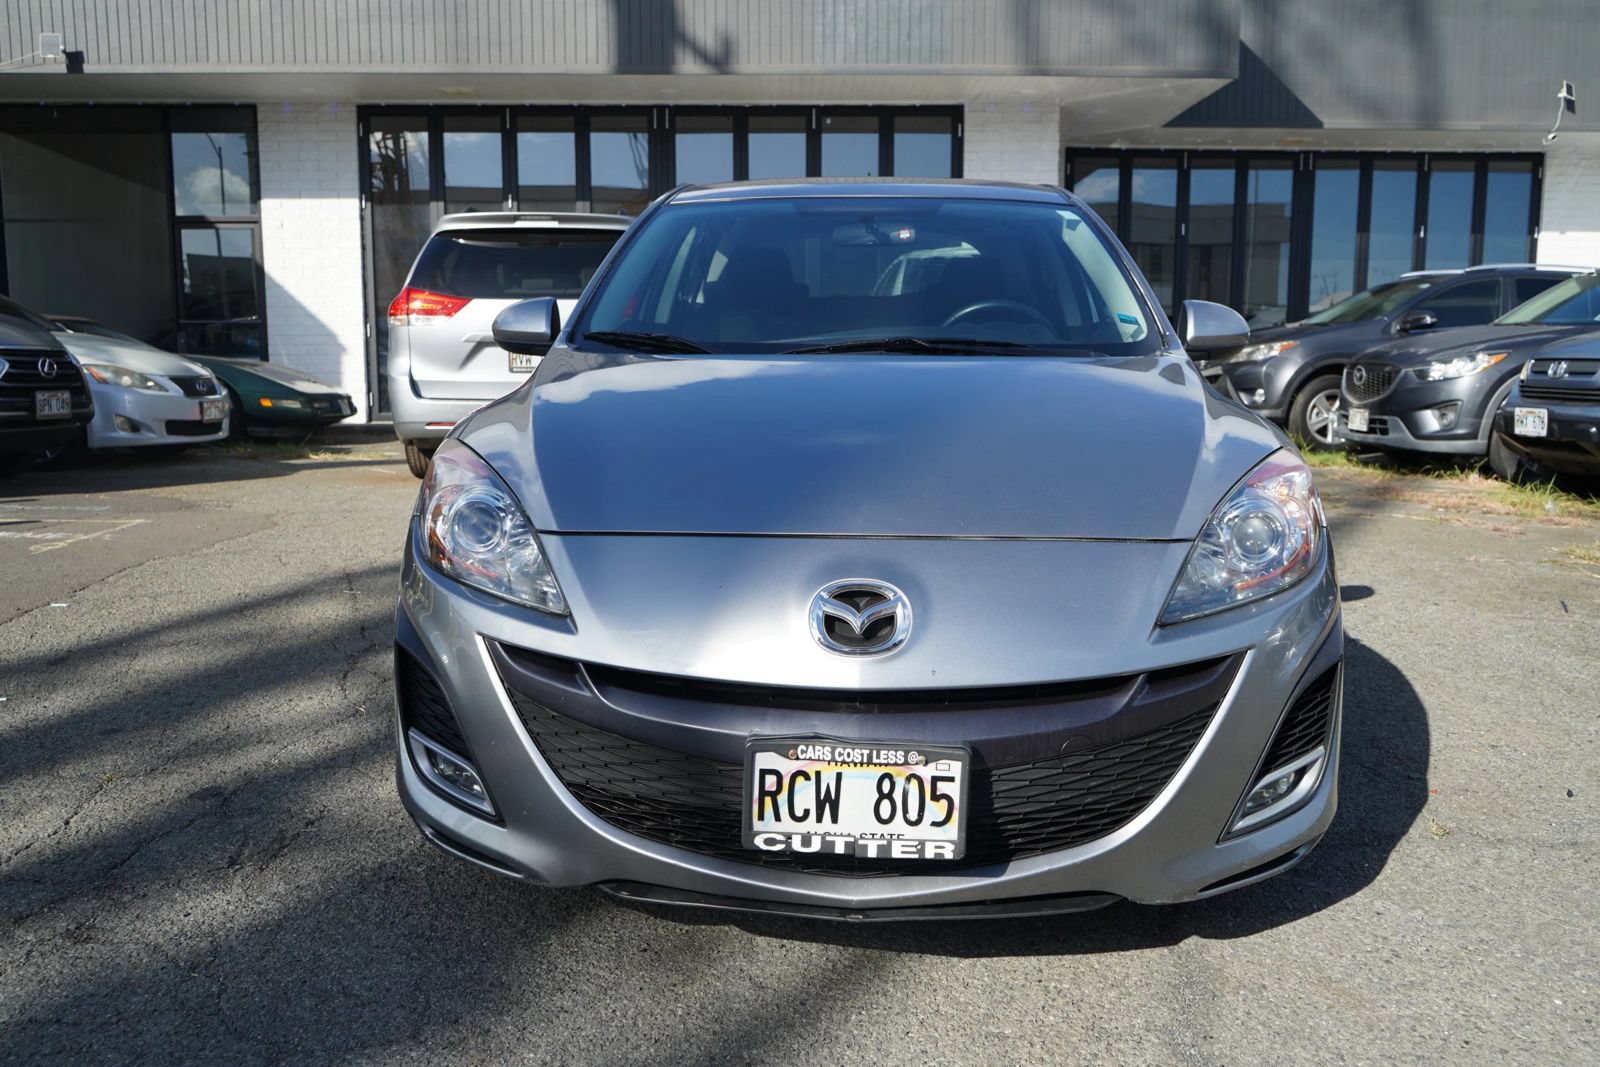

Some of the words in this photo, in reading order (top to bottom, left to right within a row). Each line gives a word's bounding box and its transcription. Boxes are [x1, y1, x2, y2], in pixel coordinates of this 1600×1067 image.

[797, 744, 832, 761] CARS
[834, 747, 870, 763] COST
[872, 750, 905, 764] LESS
[757, 768, 843, 825] RCW
[873, 771, 956, 828] 805
[753, 833, 954, 859] CUTTER
